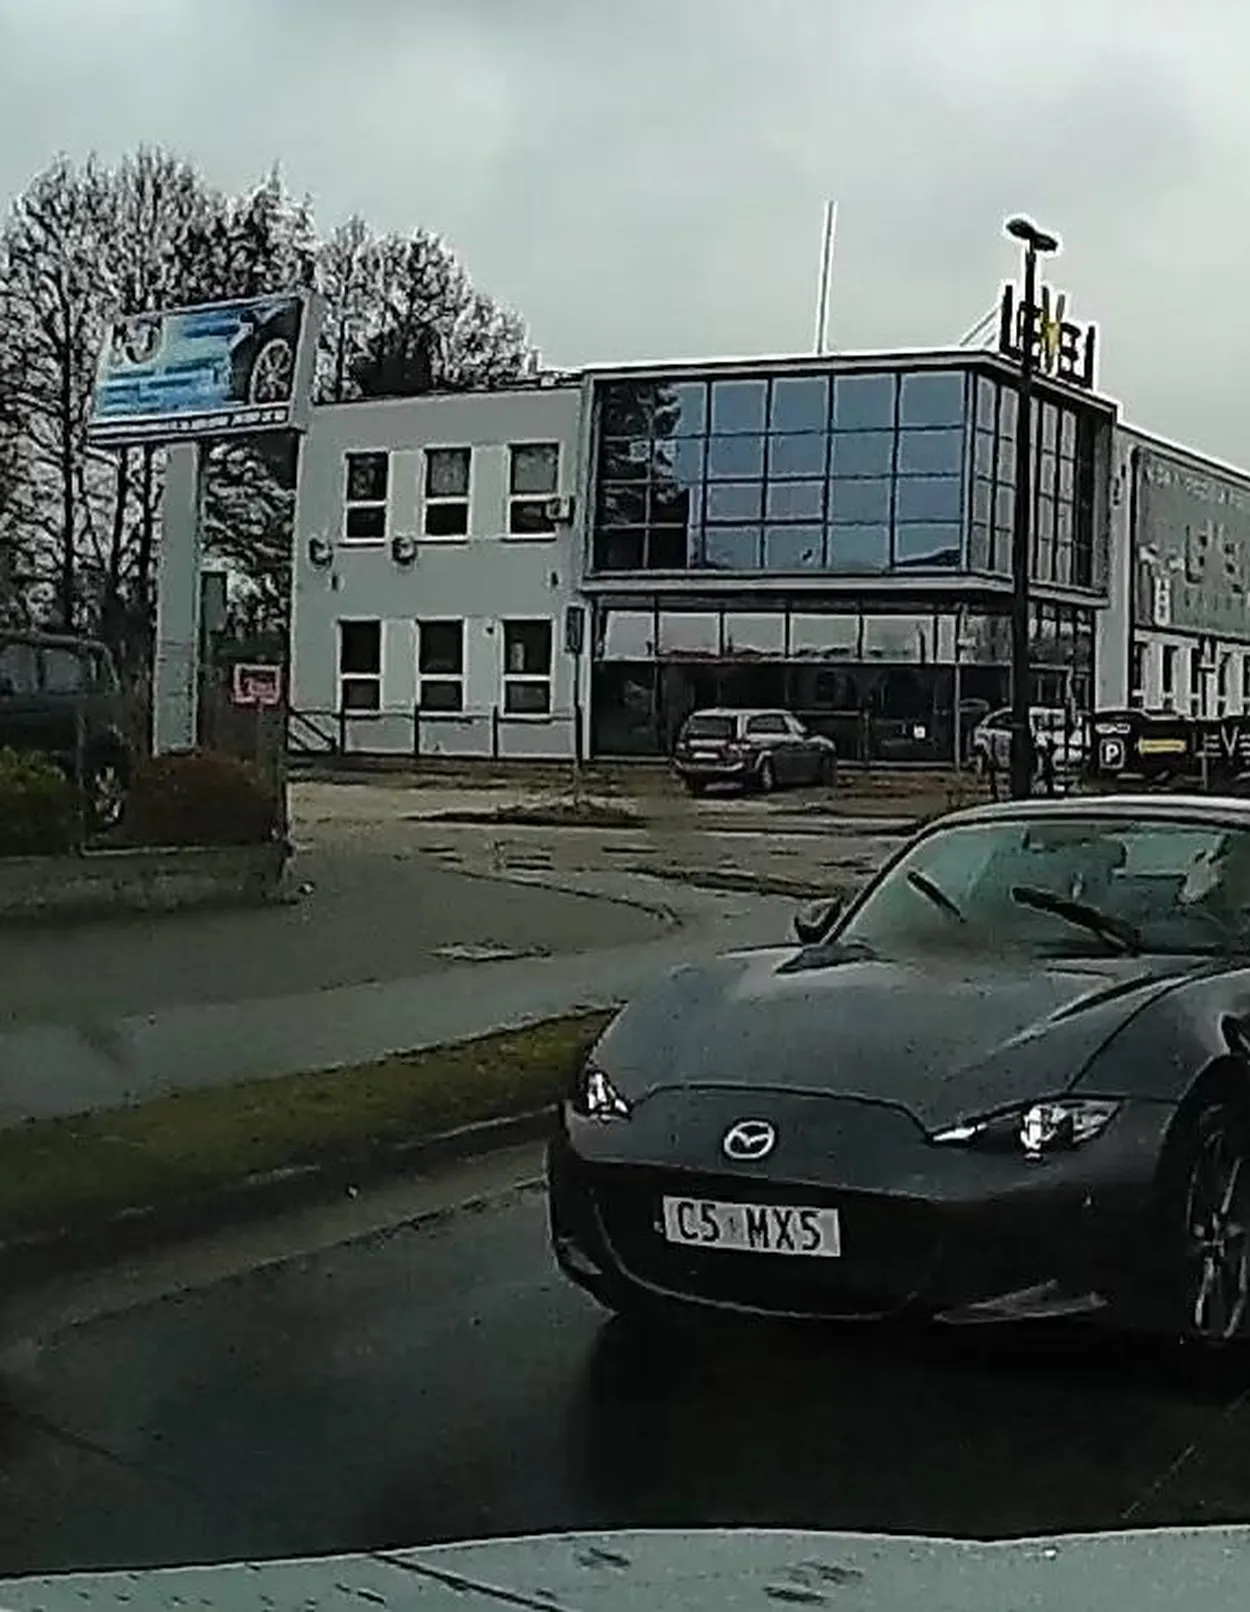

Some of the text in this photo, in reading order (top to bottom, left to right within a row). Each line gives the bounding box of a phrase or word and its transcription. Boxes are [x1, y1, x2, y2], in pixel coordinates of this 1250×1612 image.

[1105, 742, 1120, 763] P
[677, 1200, 821, 1251] C5 MX5
